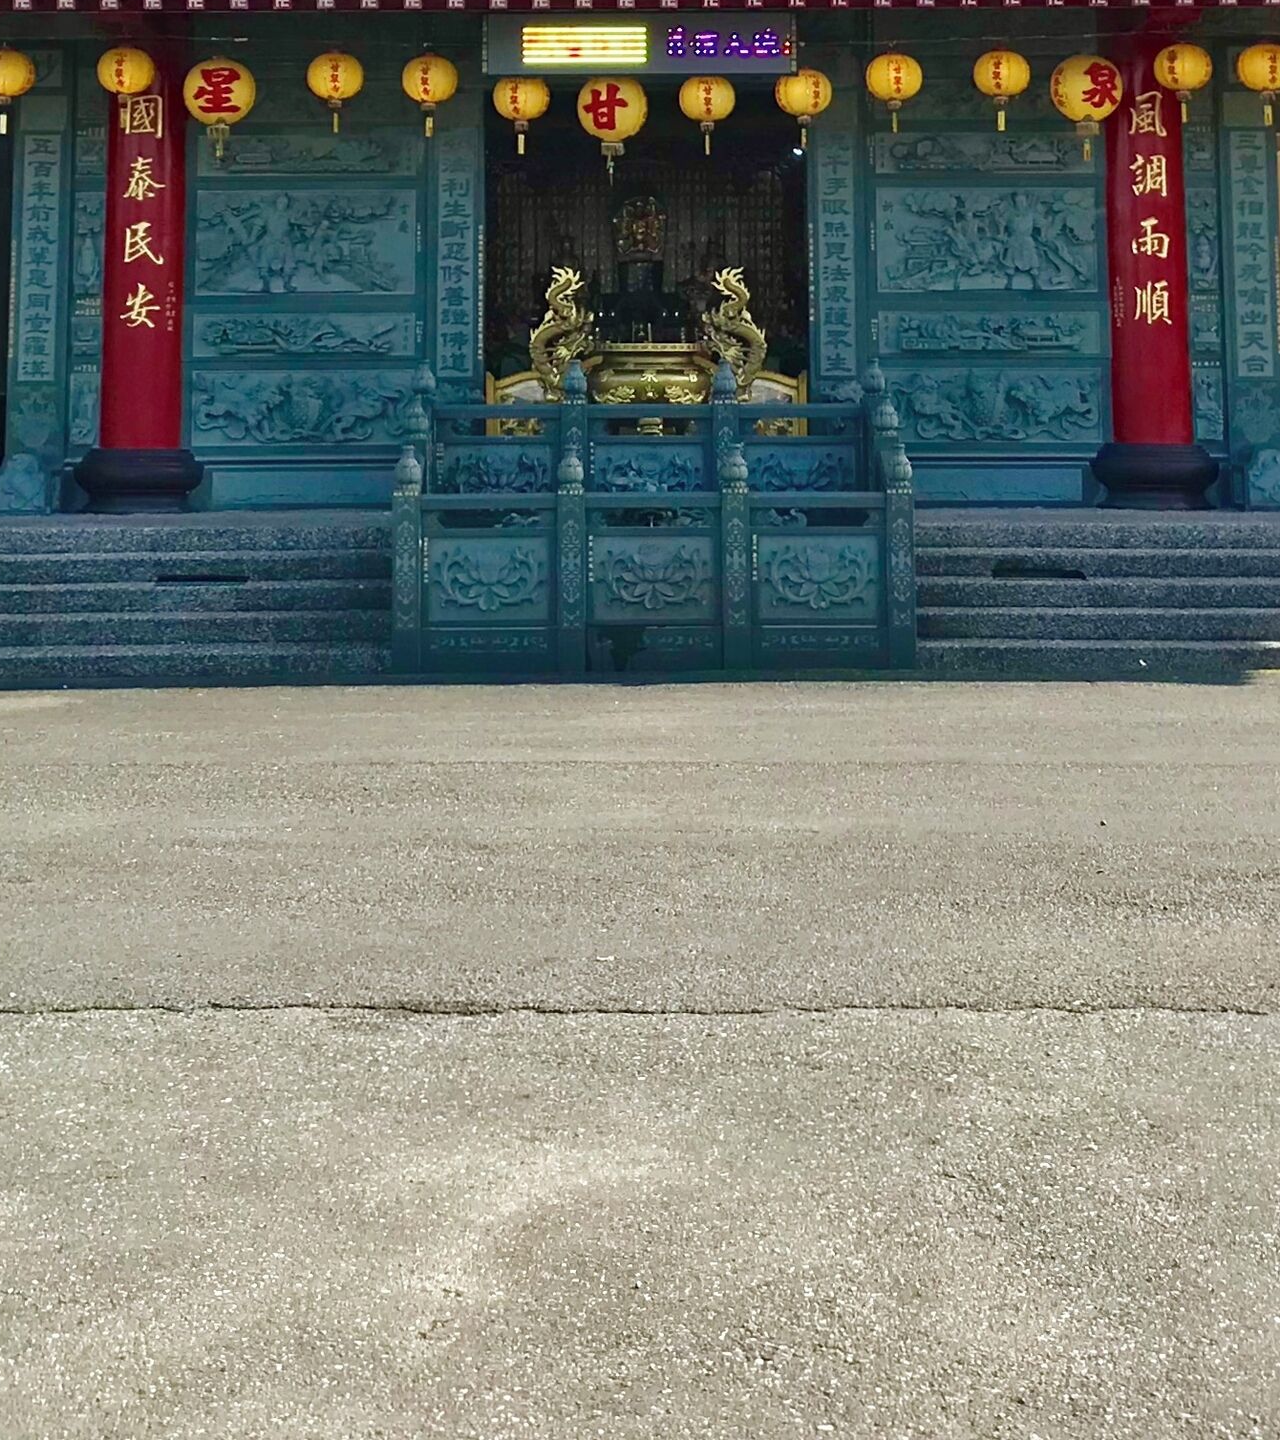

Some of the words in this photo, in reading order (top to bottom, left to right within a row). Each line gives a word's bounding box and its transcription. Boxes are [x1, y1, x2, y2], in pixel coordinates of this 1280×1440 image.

[193, 66, 242, 114] 星
[582, 82, 629, 132] 甘
[1081, 61, 1119, 109] 泉
[120, 93, 166, 329] 國泰民安
[1128, 90, 1173, 326] 風調雨順
